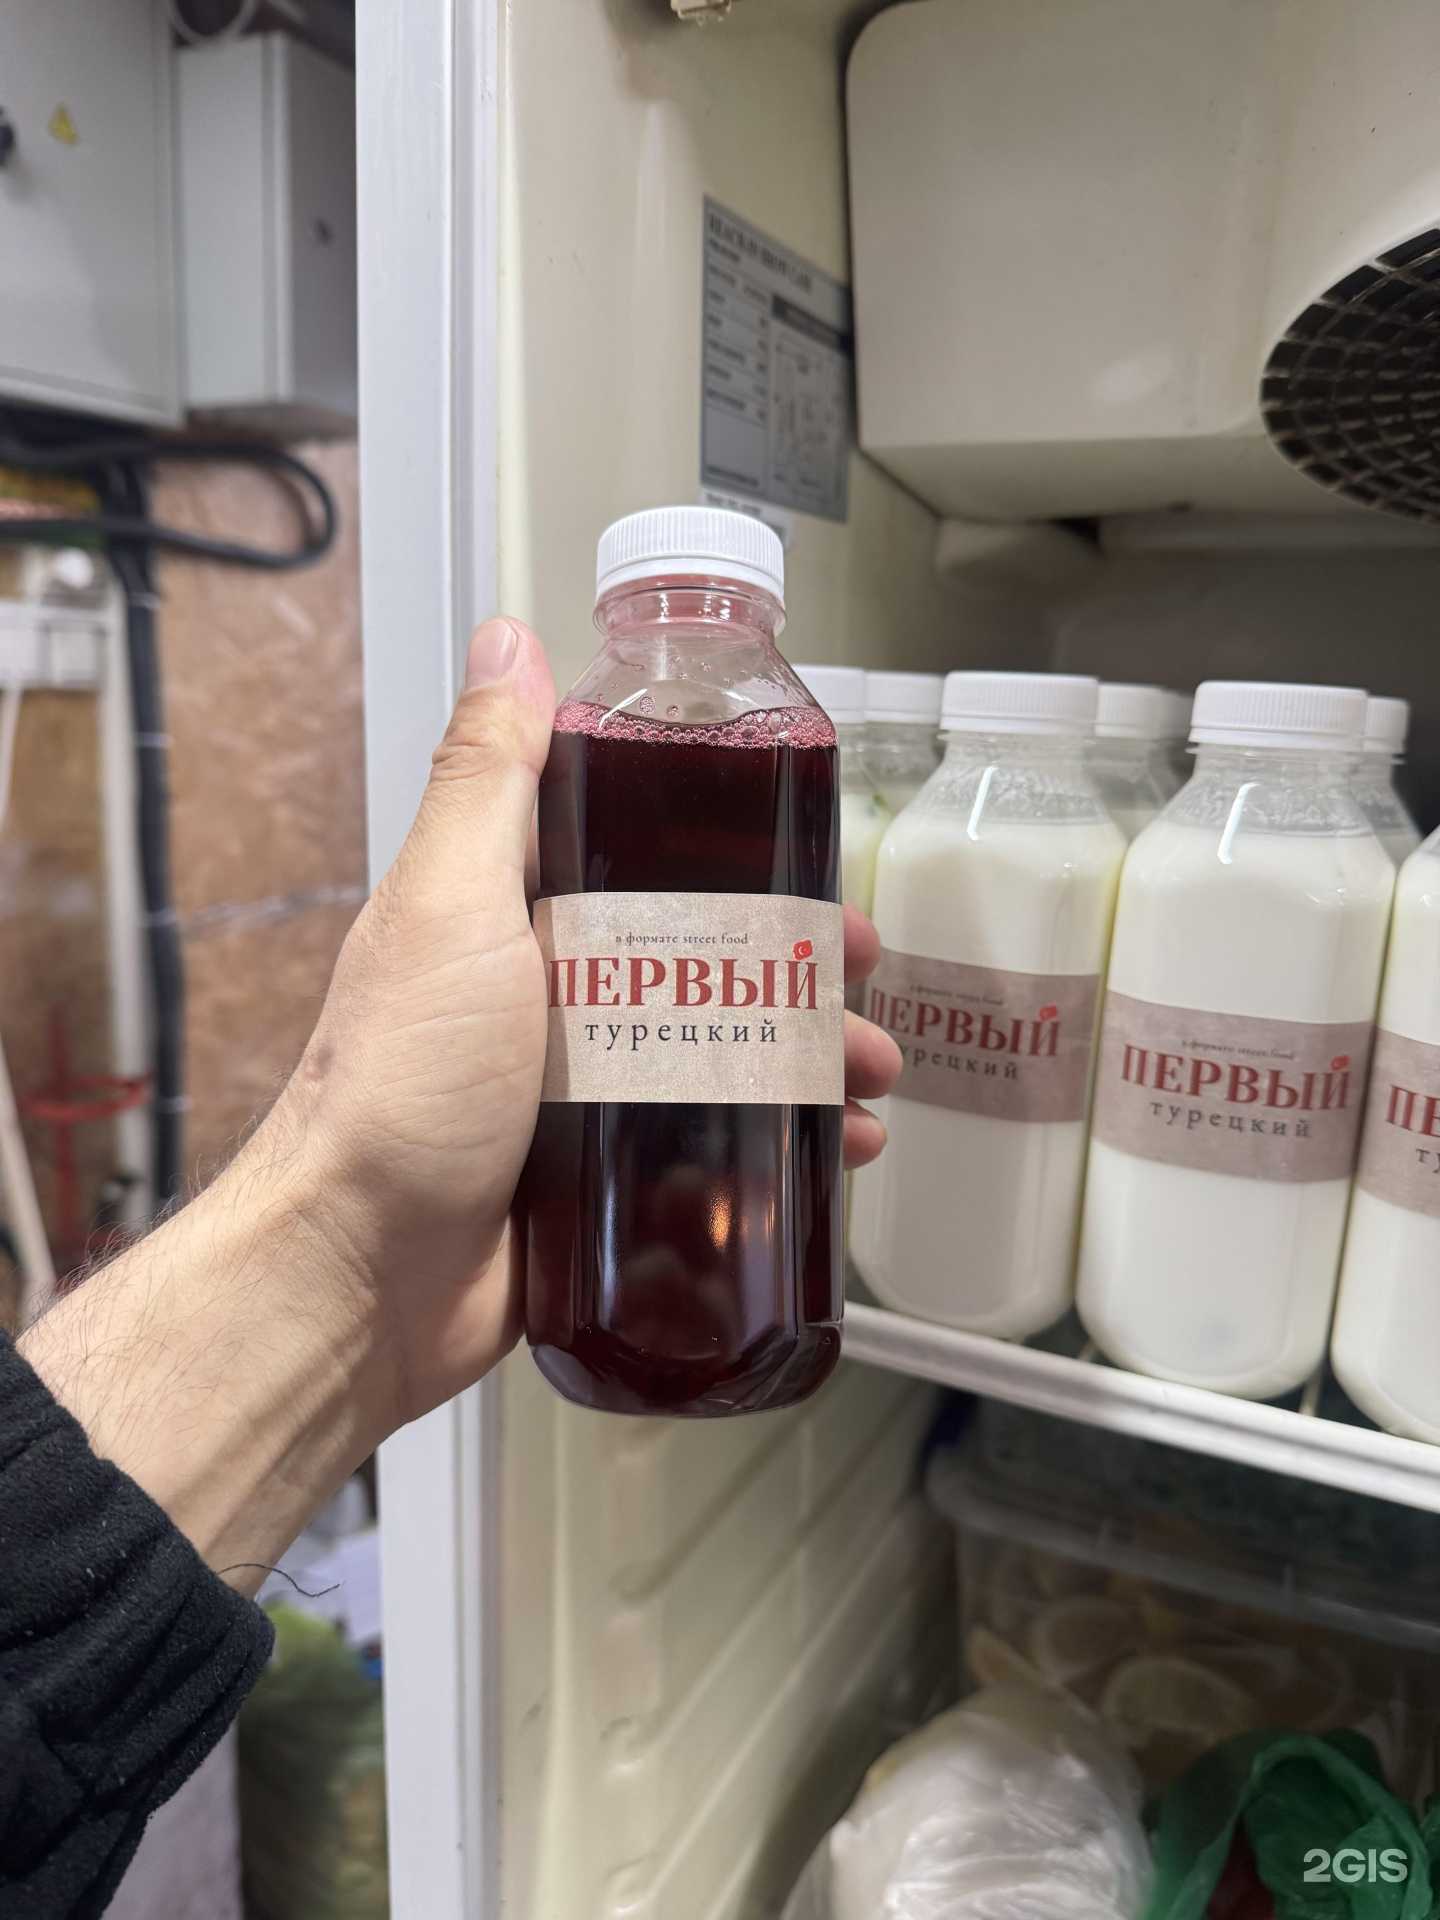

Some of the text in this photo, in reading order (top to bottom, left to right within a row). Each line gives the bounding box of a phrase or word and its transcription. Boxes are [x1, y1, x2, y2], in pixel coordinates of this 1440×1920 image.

[626, 931, 678, 946] формате
[682, 933, 716, 944] street
[721, 931, 749, 945] food
[548, 941, 818, 1010] ПЕРВЫЙ
[585, 1019, 777, 1051] турецкий
[869, 987, 1060, 1057] ПЕРВЫЙ
[900, 1043, 1018, 1080] рецкий
[1121, 1044, 1351, 1112] ПЕРВЫЙ
[1150, 1101, 1312, 1138] турецкий
